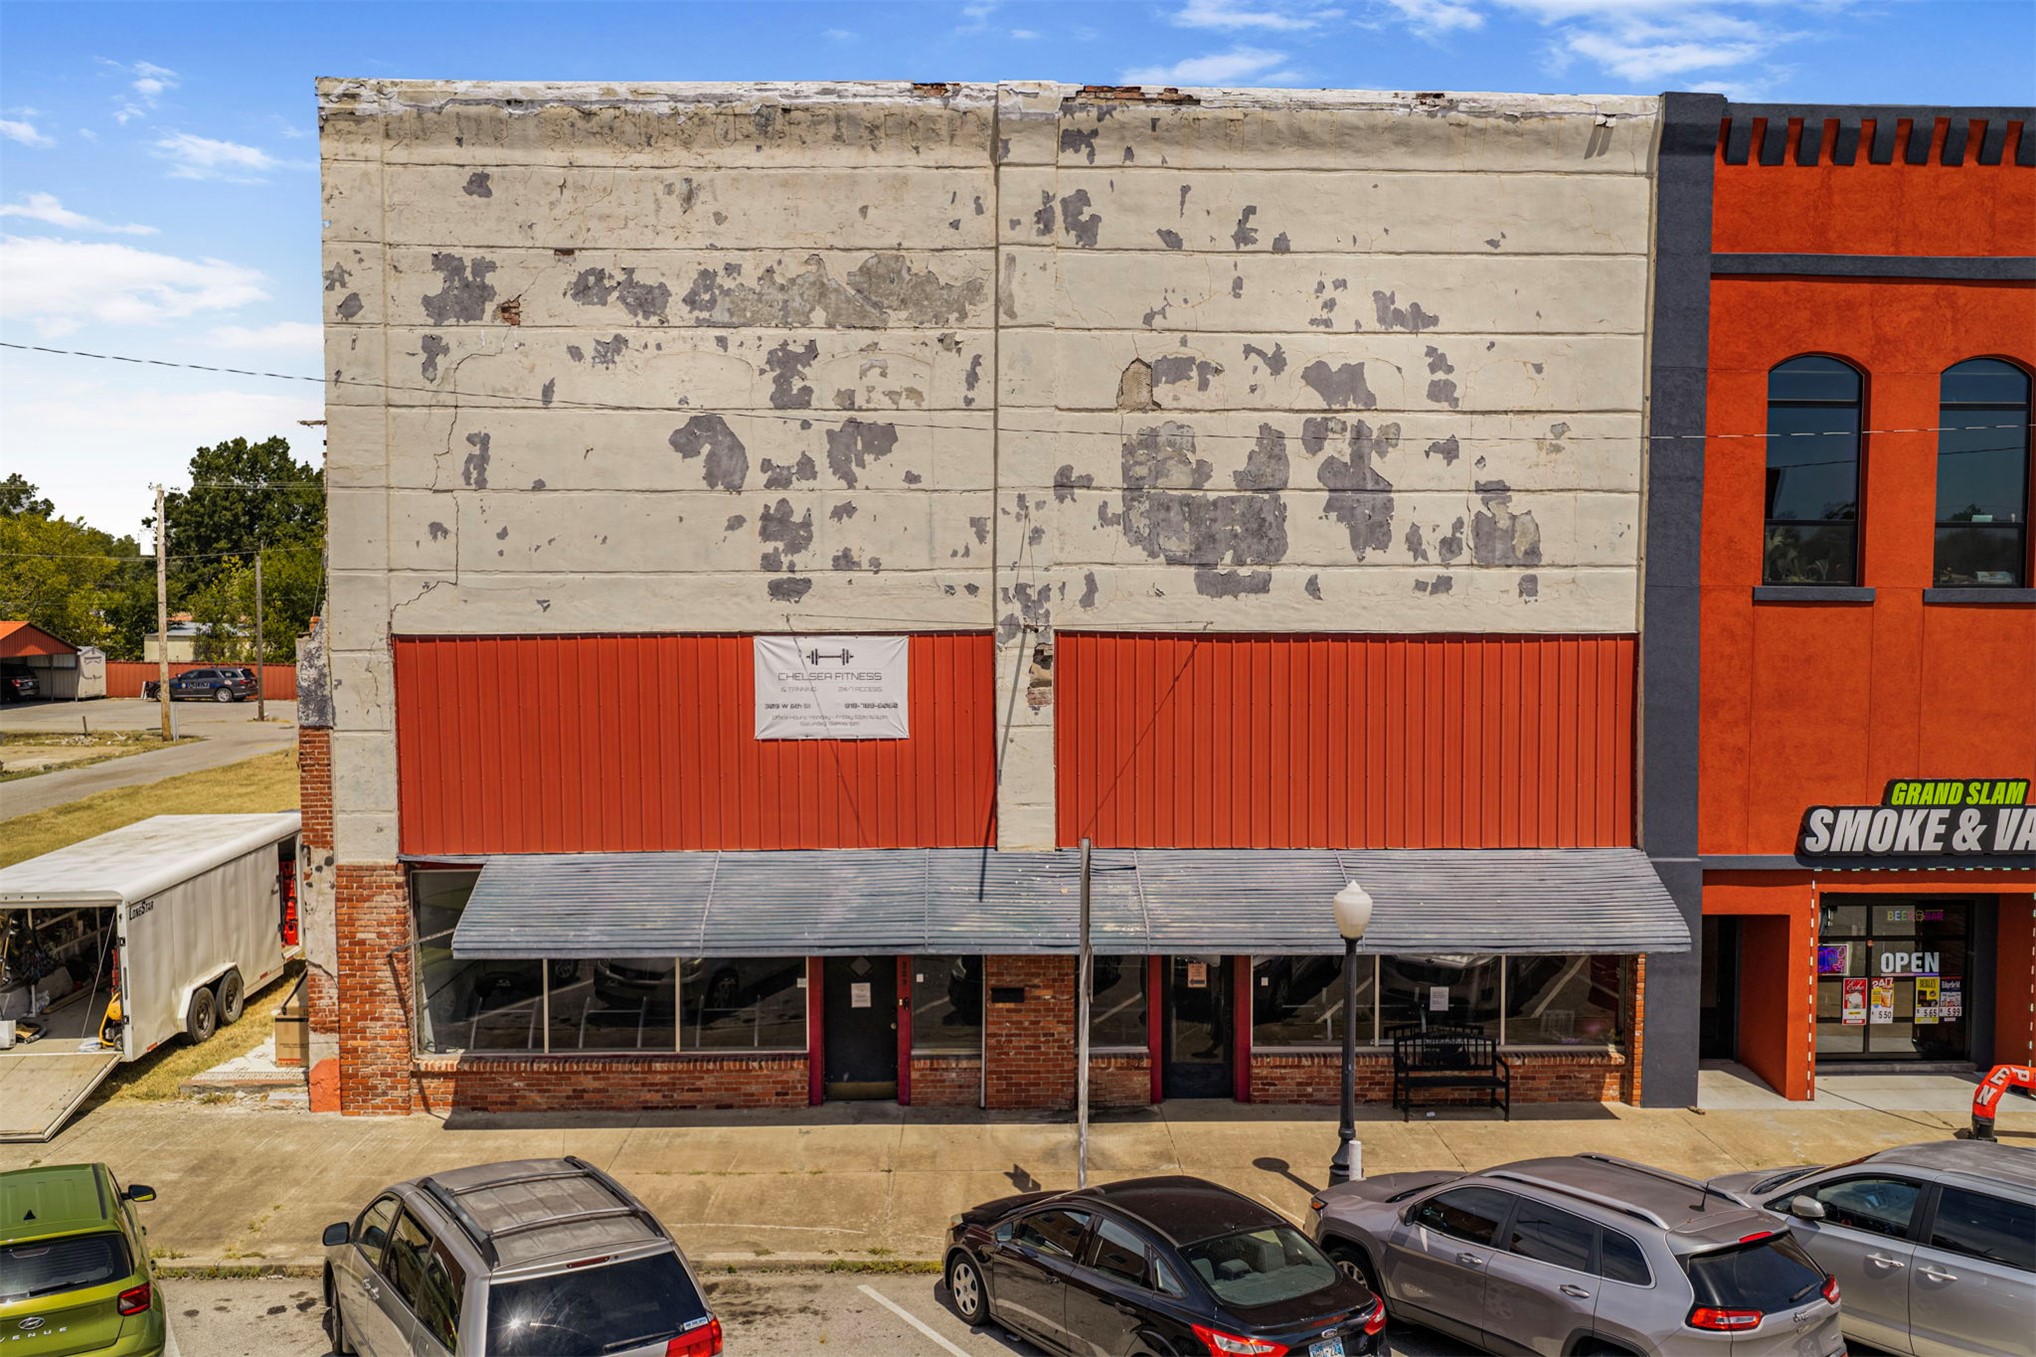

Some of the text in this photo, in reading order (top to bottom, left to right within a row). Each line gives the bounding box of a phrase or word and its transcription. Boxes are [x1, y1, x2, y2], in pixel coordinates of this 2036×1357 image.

[778, 672, 882, 681] CHELSEA FITNESS
[1891, 781, 2026, 805] GRAND SLAM
[1804, 808, 1951, 852] SMOKE
[1952, 808, 1987, 851] &
[1887, 910, 1944, 921] BEER BAR
[1880, 952, 1940, 973] OPEN
[1976, 1067, 2036, 1106] PEN
